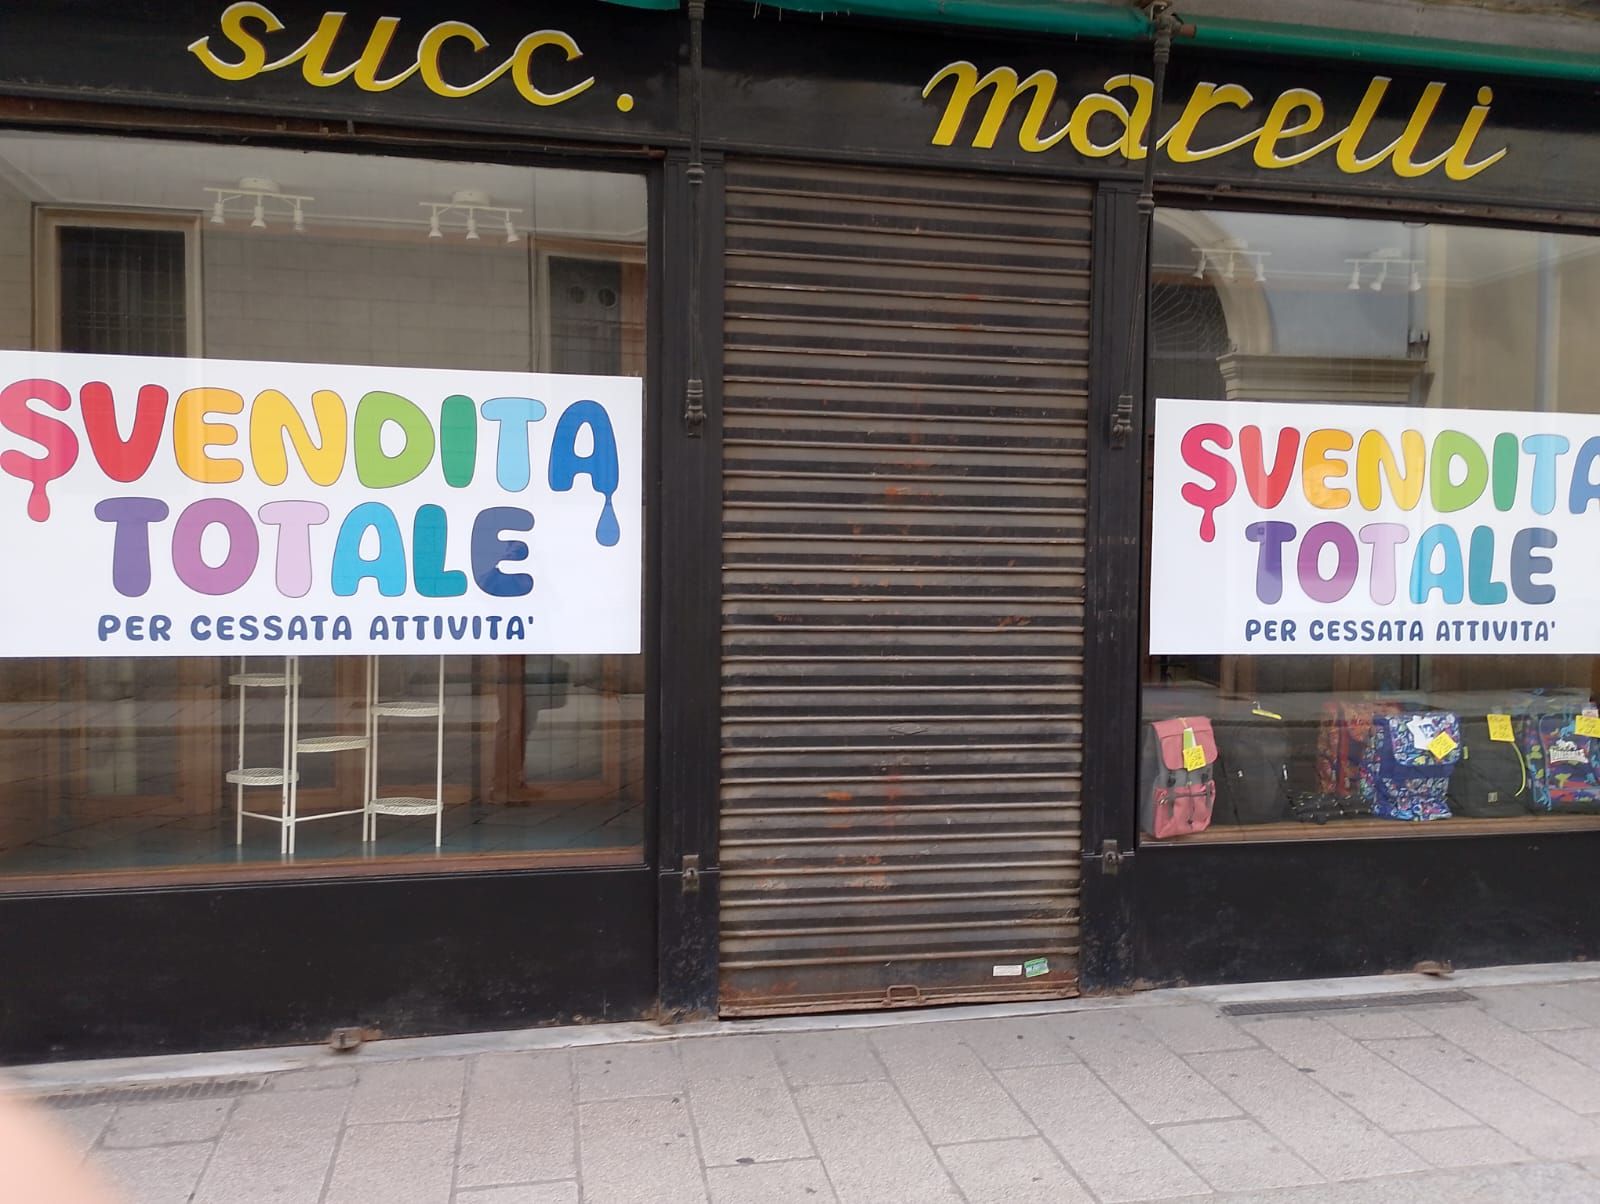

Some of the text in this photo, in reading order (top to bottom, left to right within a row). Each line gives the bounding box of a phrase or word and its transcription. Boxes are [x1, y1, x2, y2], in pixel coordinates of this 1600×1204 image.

[187, 1, 634, 112] succ.
[922, 60, 1507, 181] marelli
[0, 378, 621, 547] SVENDITA
[94, 496, 536, 598] TOTALE
[1244, 520, 1558, 606] TOTALE
[97, 614, 535, 642] PER CESSATA ATTIVITA'
[1245, 619, 1556, 642] PER CESSATA ATTIVITA'
